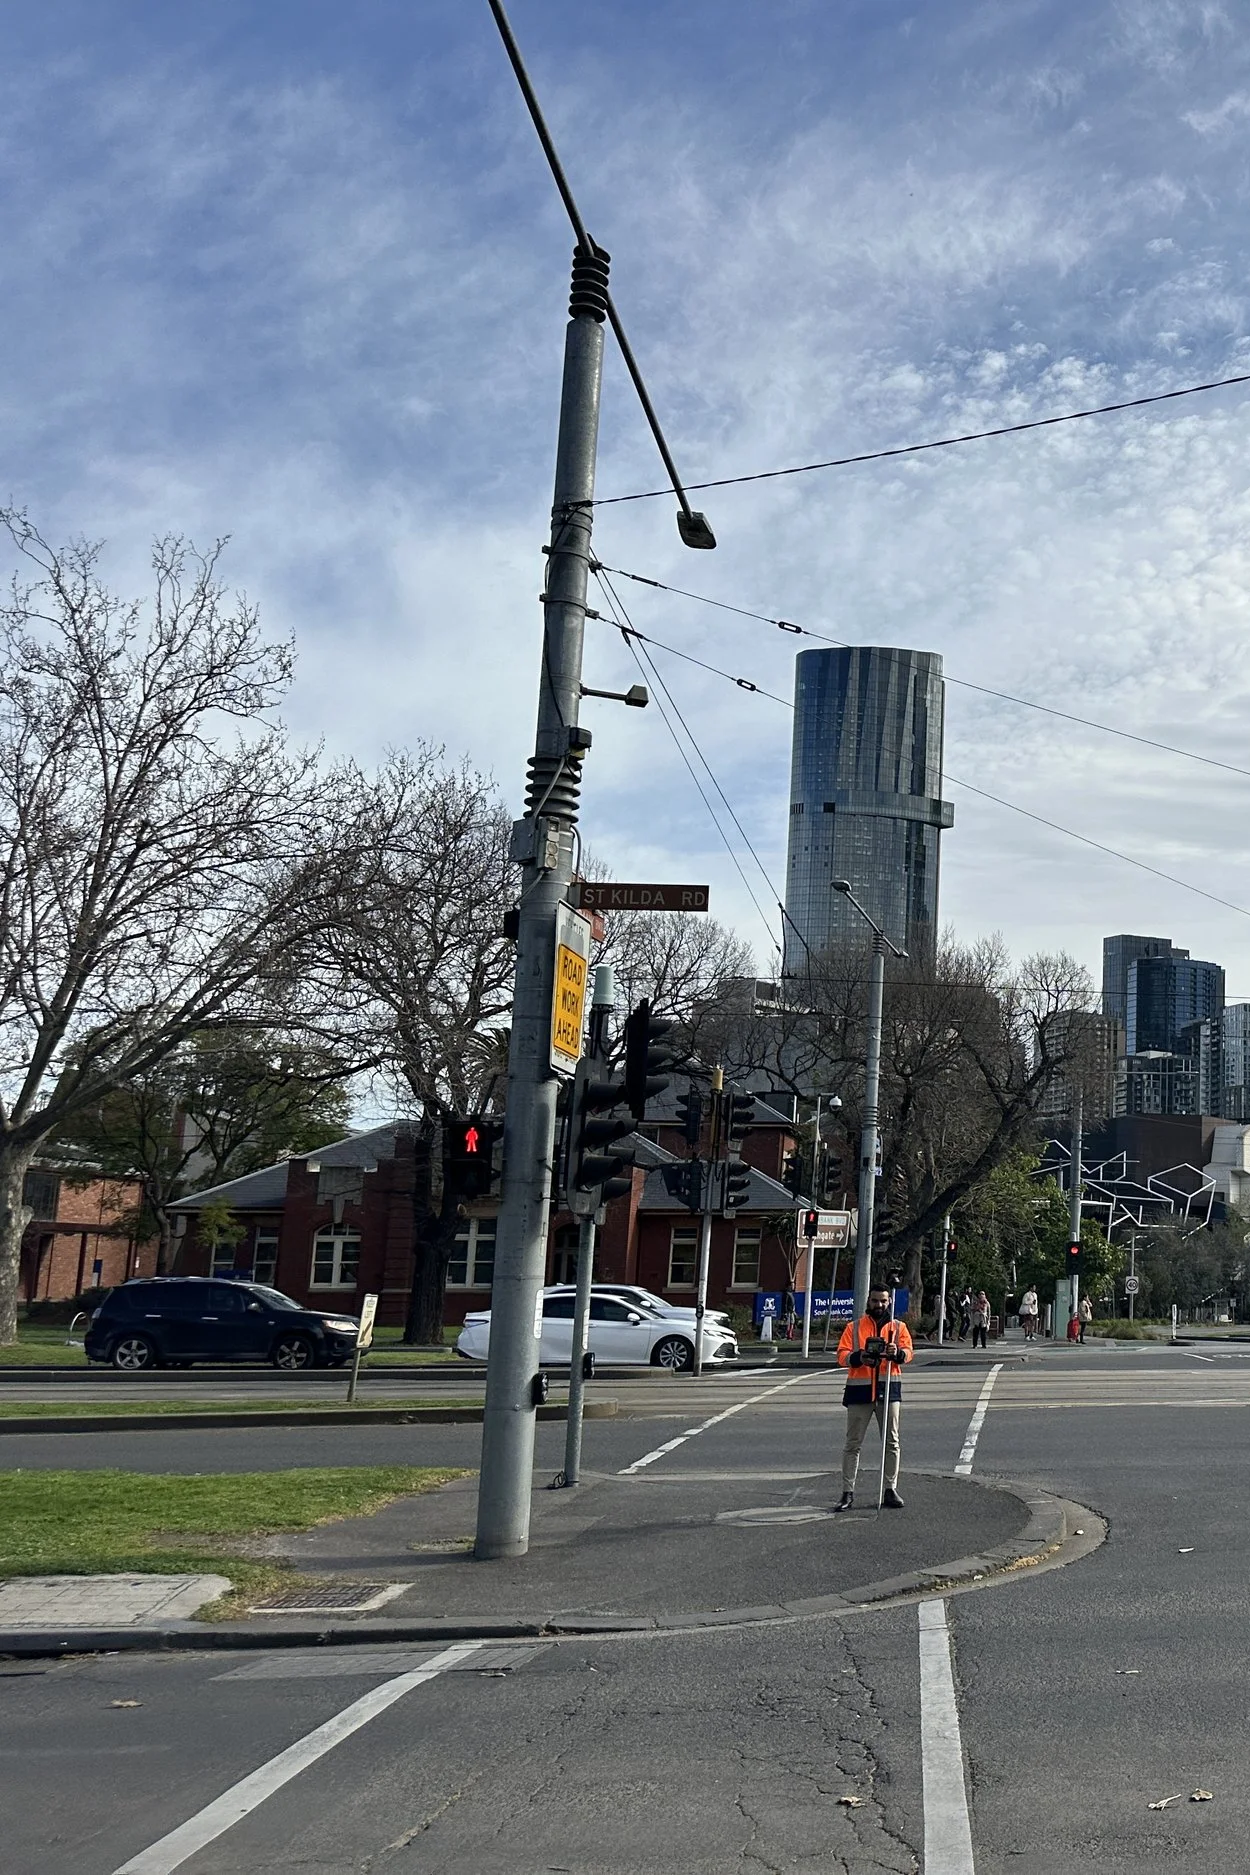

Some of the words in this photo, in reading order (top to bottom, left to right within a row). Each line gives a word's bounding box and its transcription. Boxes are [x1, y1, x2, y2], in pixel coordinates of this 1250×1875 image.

[583, 888, 605, 904] ST
[611, 889, 665, 905] KILDA
[681, 891, 706, 906] RD
[562, 956, 582, 986] ROAD
[561, 988, 580, 1018] WORK
[556, 1018, 580, 1049] AHEAD
[814, 1298, 827, 1306] The
[827, 1297, 854, 1306] Universit
